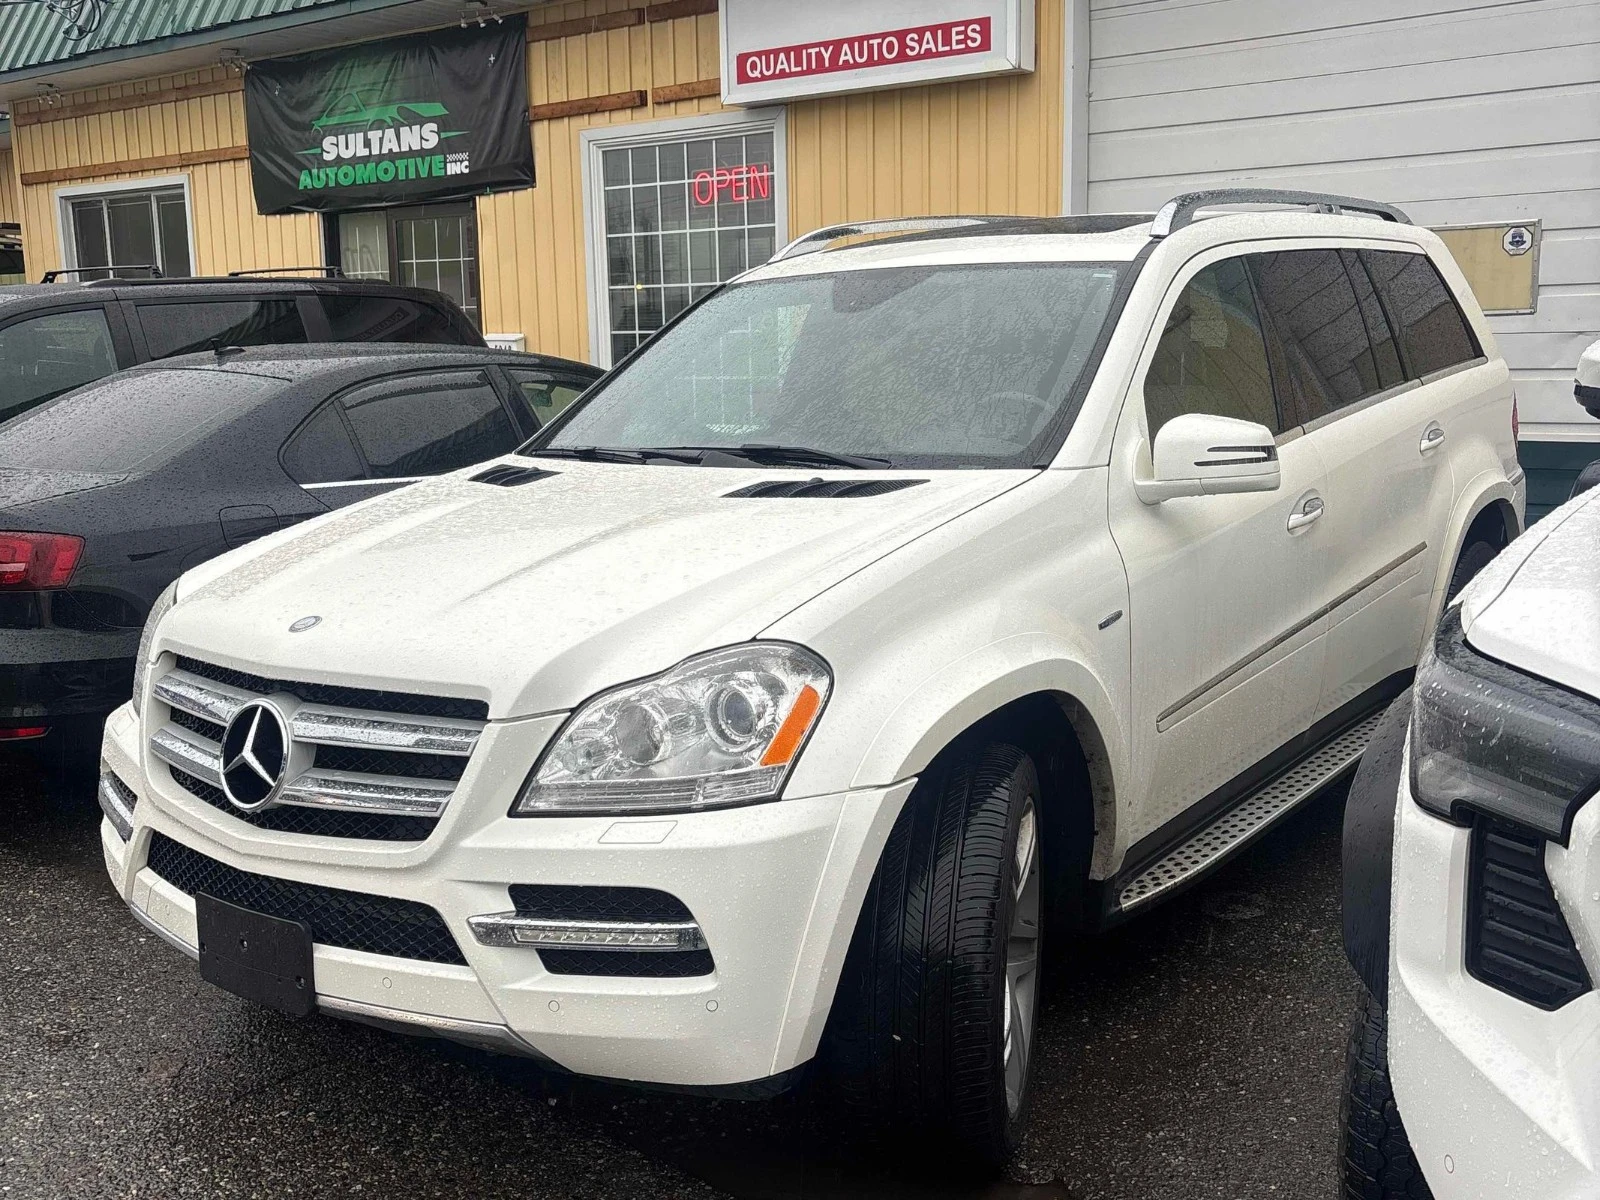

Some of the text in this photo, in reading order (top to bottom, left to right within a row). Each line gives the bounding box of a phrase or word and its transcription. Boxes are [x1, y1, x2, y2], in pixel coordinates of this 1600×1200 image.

[746, 23, 982, 78] QUALITY AUTO SALES
[322, 122, 439, 161] SULTANS
[299, 154, 470, 190] AUTOMOTIVE INC
[694, 164, 768, 205] OPEN
